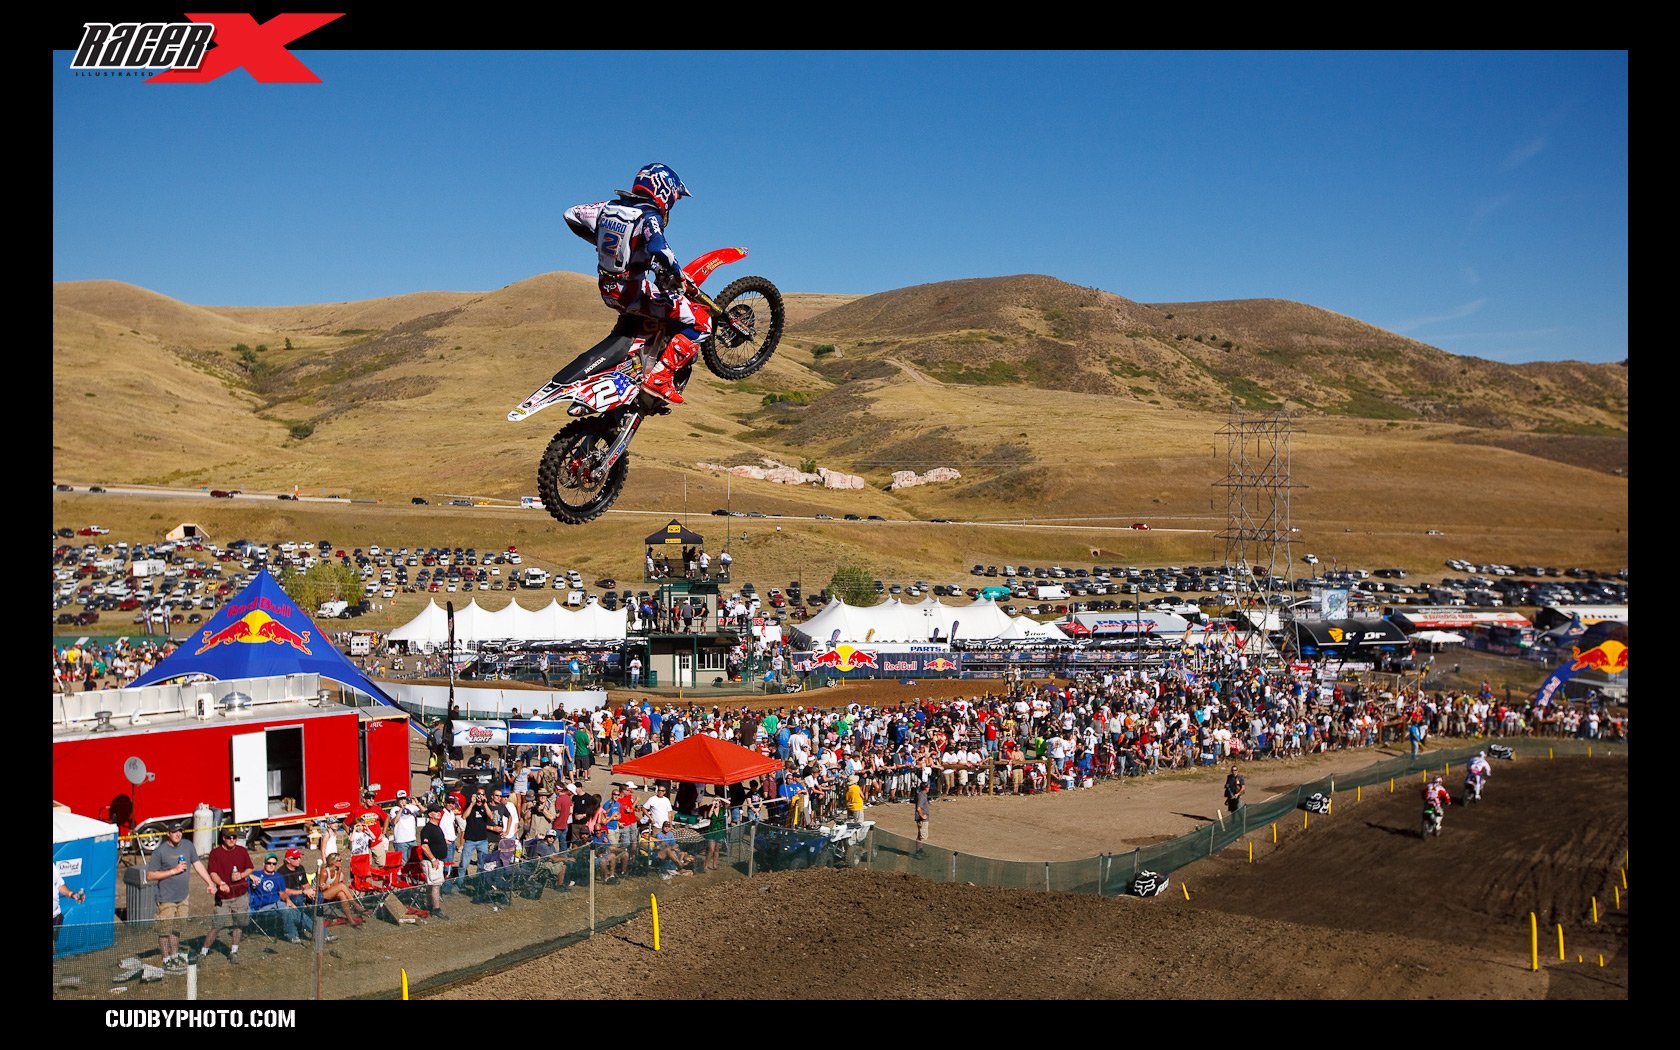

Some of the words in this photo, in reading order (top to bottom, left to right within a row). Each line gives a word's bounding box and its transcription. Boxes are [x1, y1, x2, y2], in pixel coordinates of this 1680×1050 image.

[600, 219, 627, 234] CANARD
[601, 232, 623, 258] 2
[584, 357, 606, 374] HONDA
[592, 380, 621, 413] 2
[227, 596, 259, 618] Red
[260, 597, 292, 618] Bull
[1345, 631, 1387, 640] tor
[884, 660, 900, 671] Red
[900, 660, 917, 671] Bull
[469, 727, 494, 738] Coors
[469, 736, 492, 744] LIGHT
